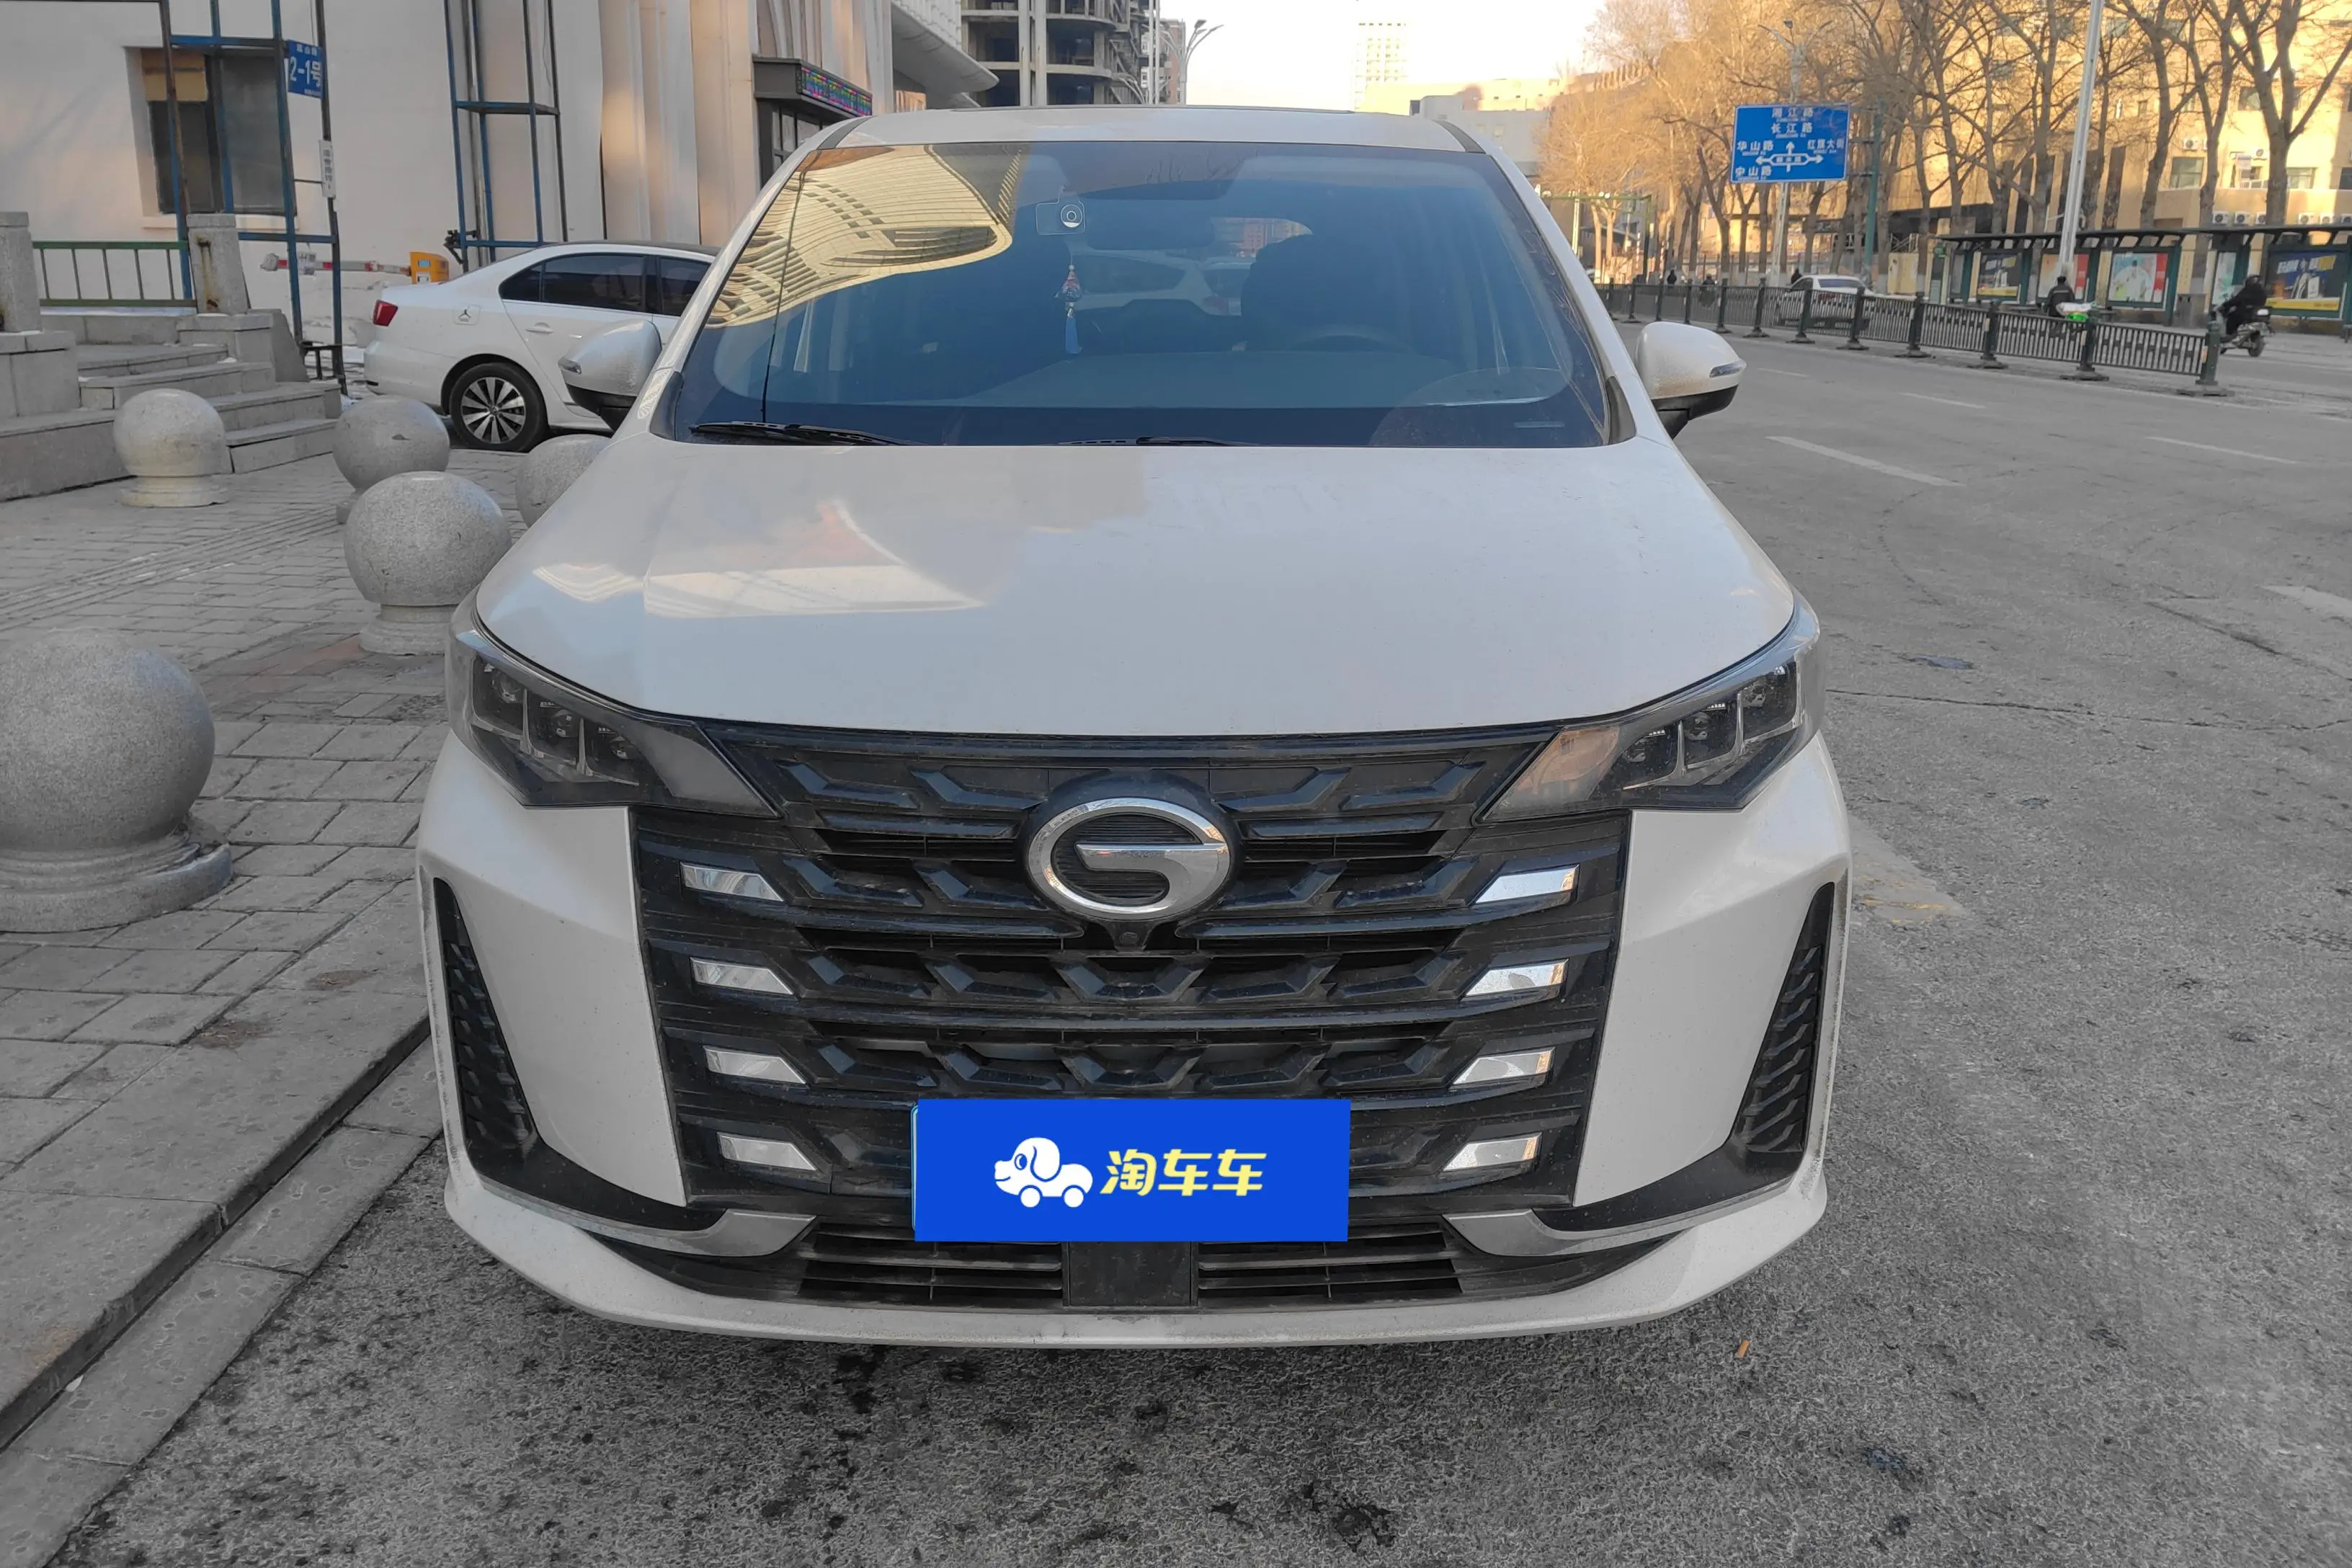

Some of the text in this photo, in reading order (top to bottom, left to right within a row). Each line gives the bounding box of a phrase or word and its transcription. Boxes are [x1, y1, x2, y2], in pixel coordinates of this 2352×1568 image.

[290, 56, 321, 87] 2-1号
[1770, 122, 1813, 134] 长江路
[1737, 140, 1774, 151] 华山路
